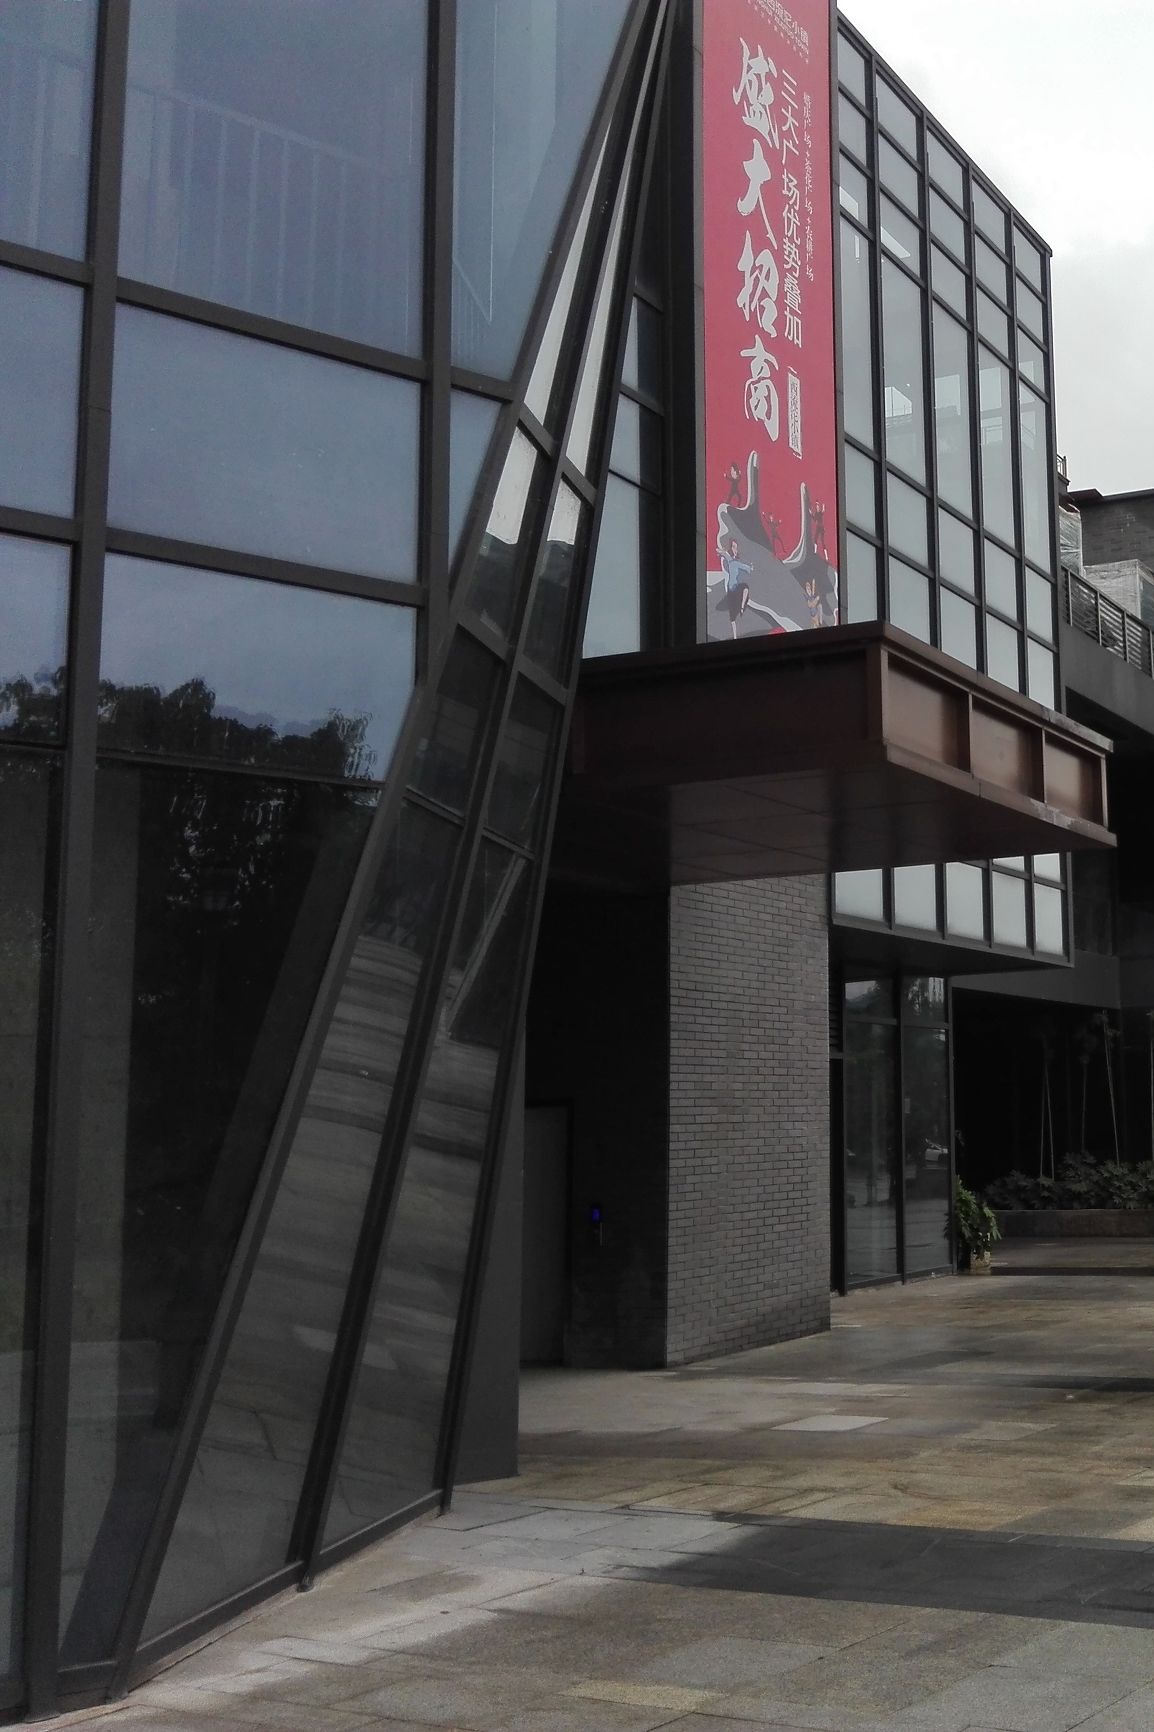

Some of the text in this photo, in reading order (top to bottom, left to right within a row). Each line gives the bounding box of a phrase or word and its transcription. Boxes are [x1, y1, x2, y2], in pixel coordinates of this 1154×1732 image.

[732, 36, 780, 442] 盛大招商
[781, 69, 802, 349] 三大广场优势叠加
